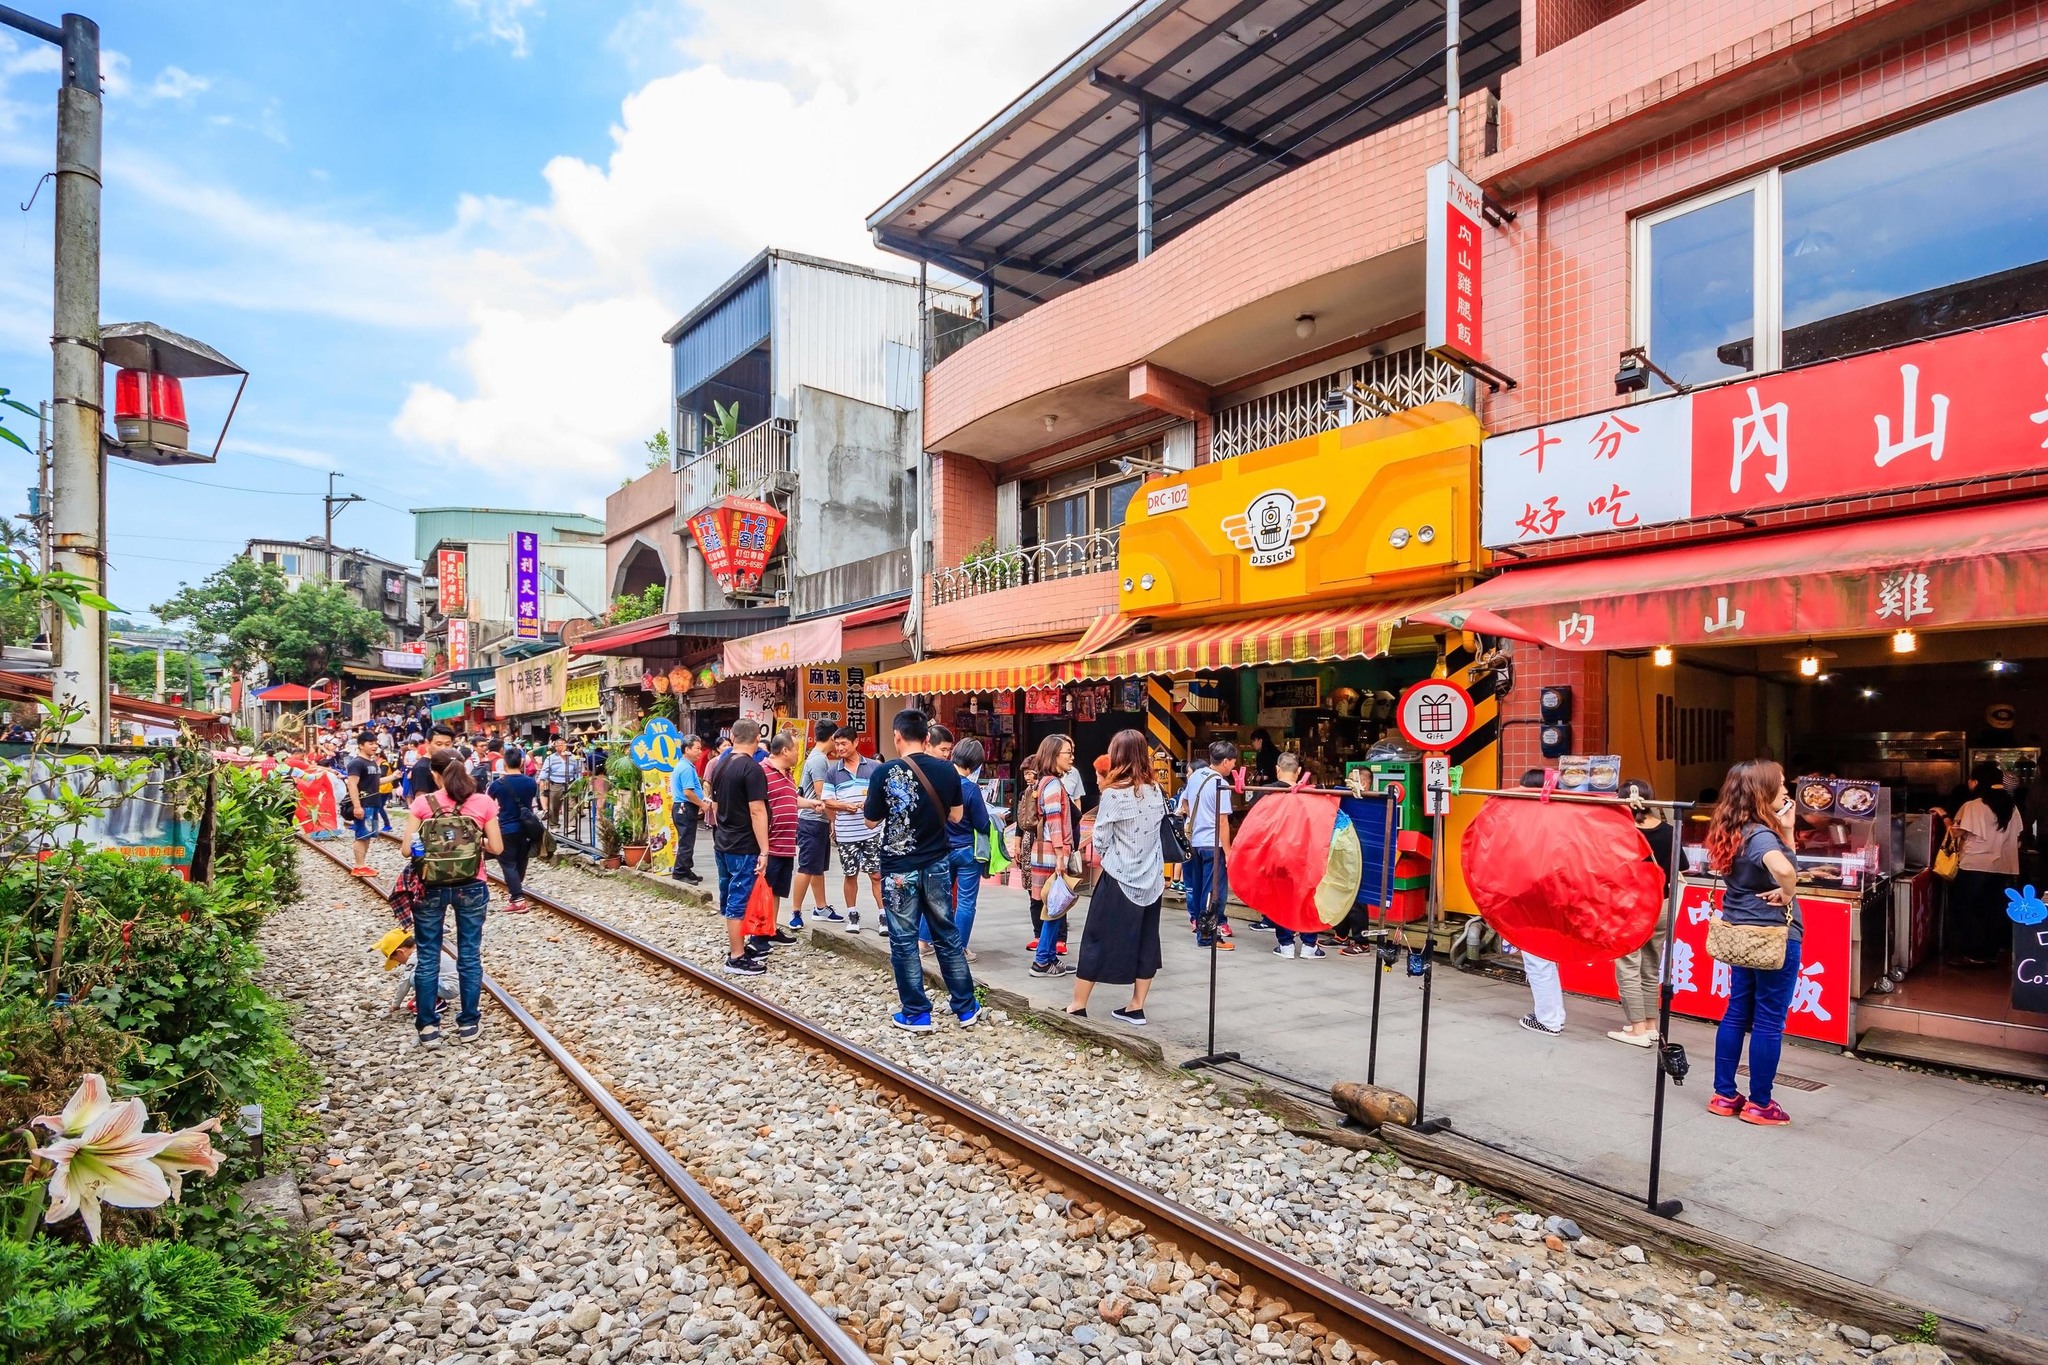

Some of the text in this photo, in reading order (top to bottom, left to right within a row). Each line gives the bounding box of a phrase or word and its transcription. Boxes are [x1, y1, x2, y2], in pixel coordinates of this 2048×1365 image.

[1448, 174, 1482, 219] 十分好吃
[1728, 348, 2048, 494] 內山
[1518, 413, 1641, 476] 十分
[1147, 488, 1188, 511] DRC-102
[1514, 483, 1640, 539] 好吃
[1251, 548, 1293, 565] DESIGN
[808, 667, 841, 686] 麻辣
[846, 666, 866, 733] 臭菇菇
[651, 722, 668, 734] Mr
[1426, 732, 1444, 740] Gift
